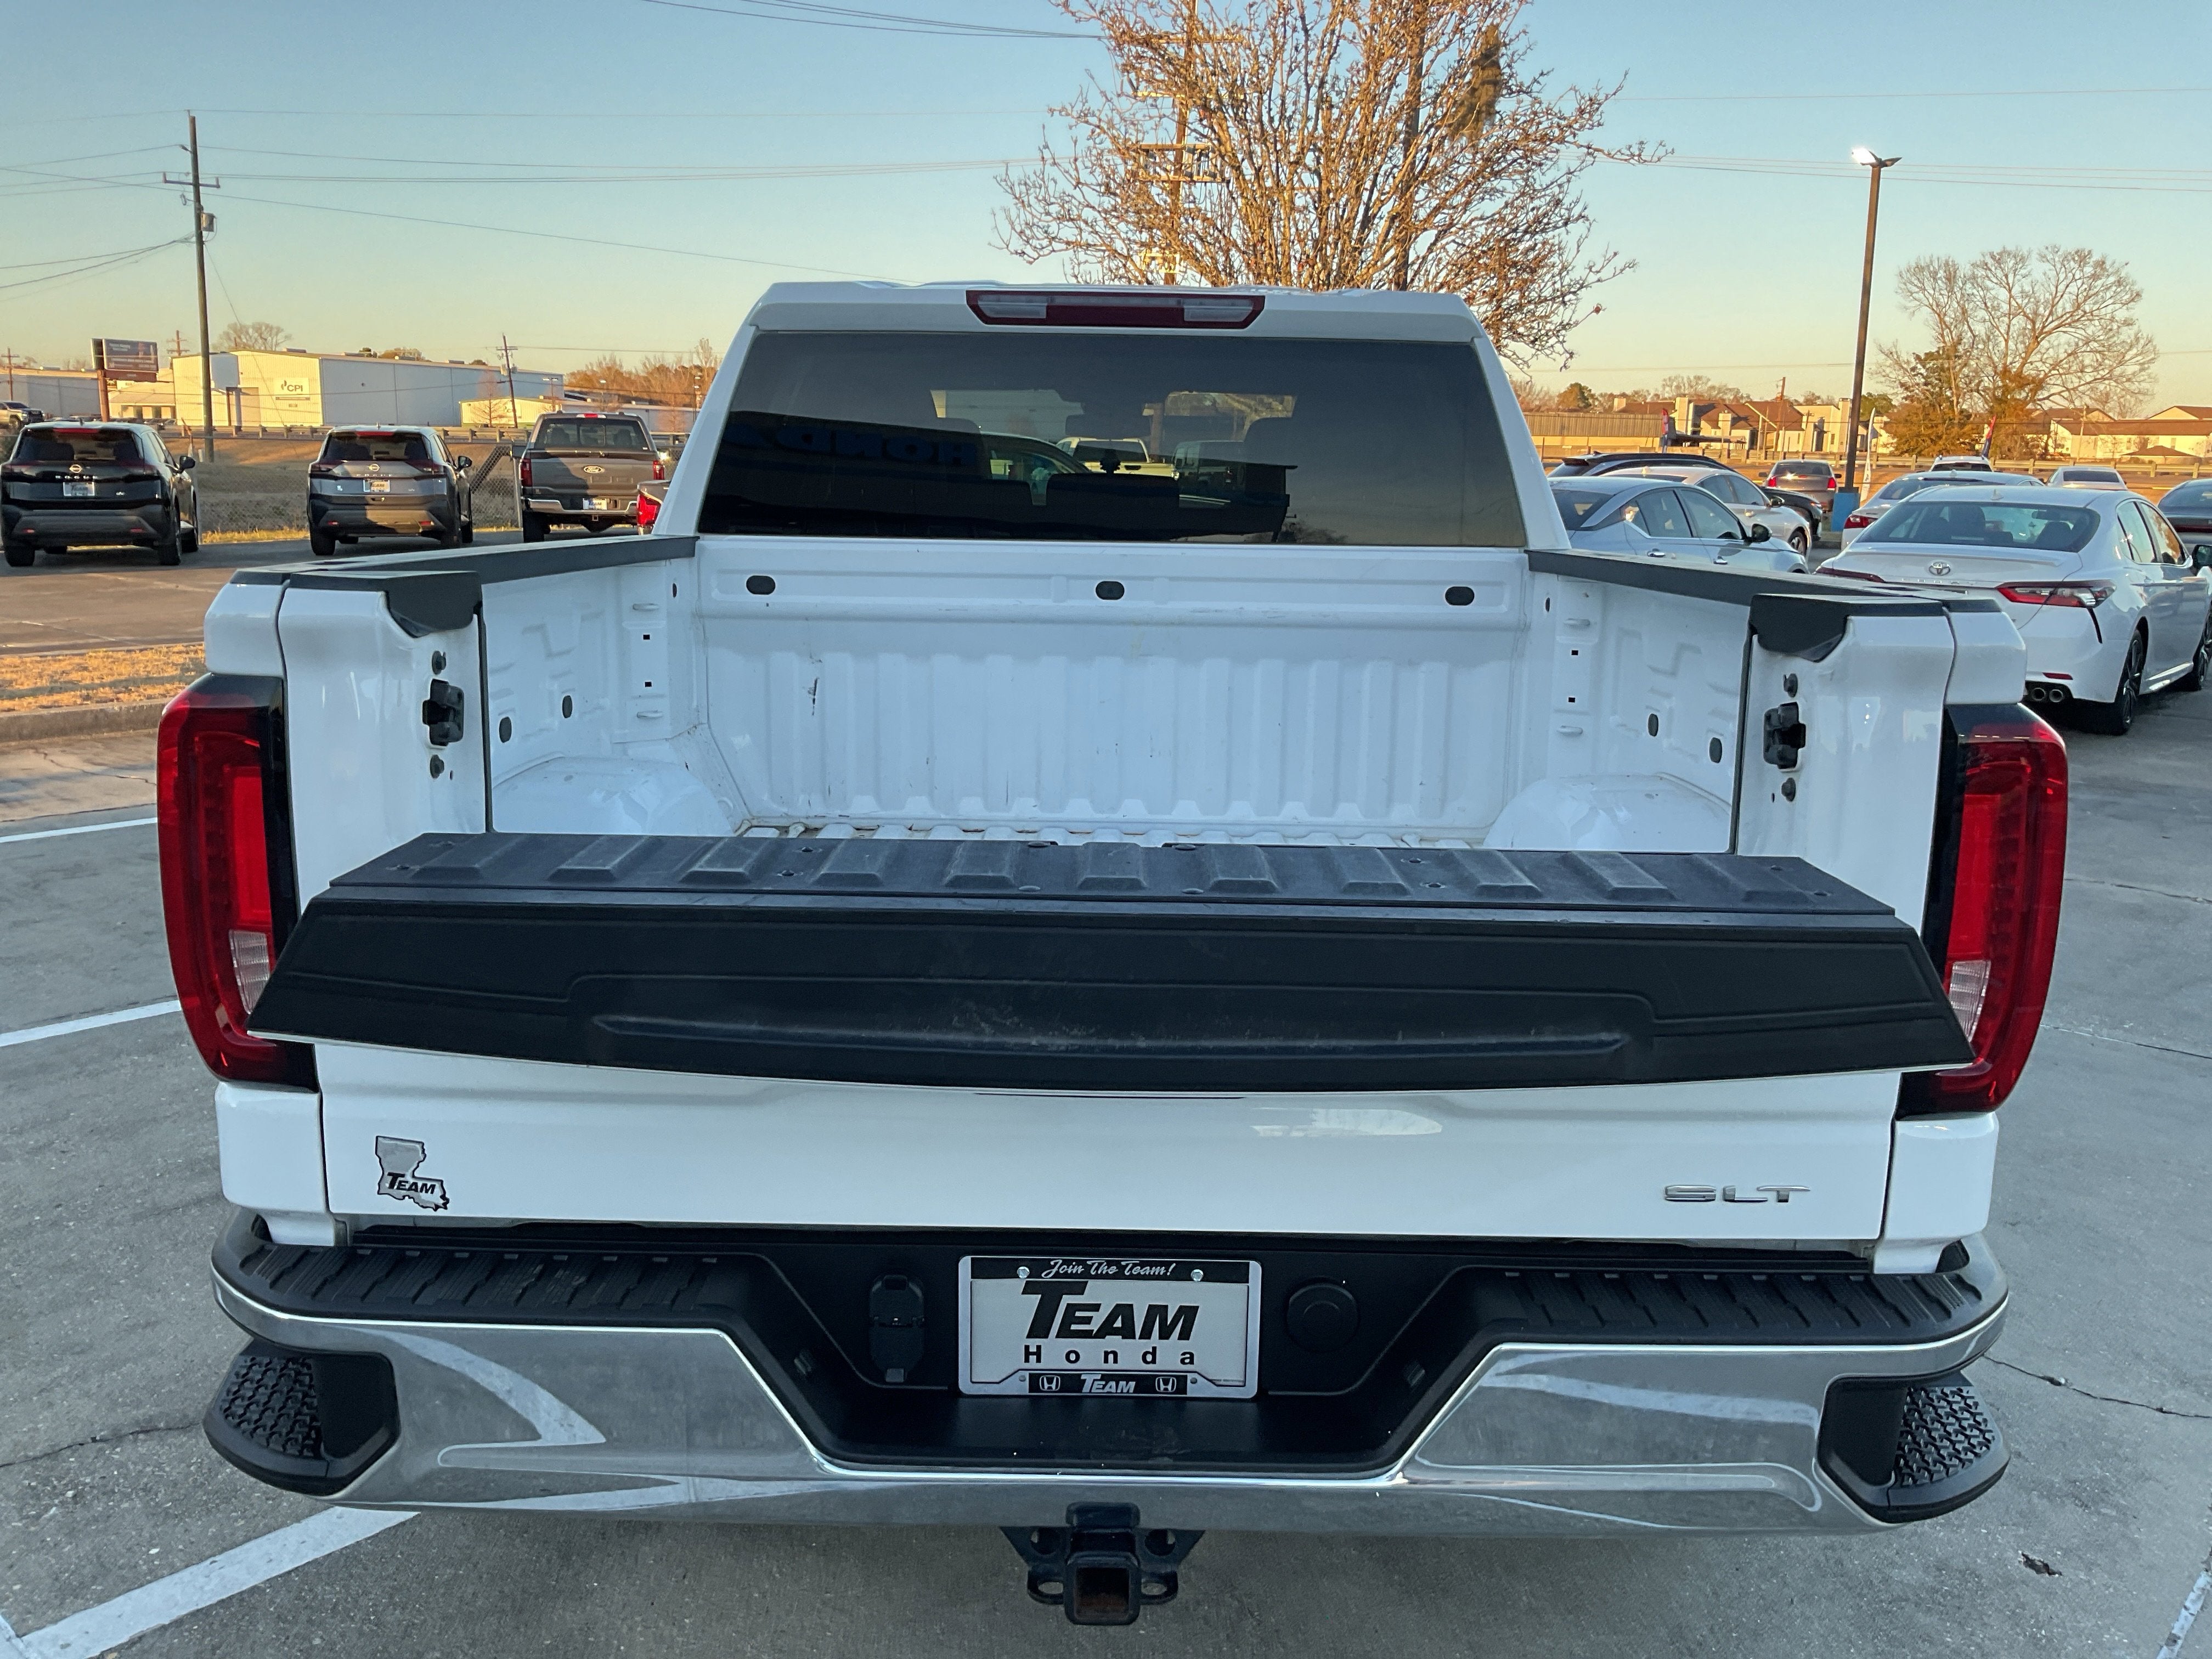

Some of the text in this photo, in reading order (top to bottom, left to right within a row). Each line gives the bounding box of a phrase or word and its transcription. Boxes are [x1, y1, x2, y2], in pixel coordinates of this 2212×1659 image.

[387, 1172, 436, 1195] TEAM
[1664, 1184, 1811, 1203] SLT
[1041, 1259, 1176, 1278] Join The Team!
[1021, 1280, 1200, 1341] TEAM
[1024, 1344, 1195, 1365] Honda
[1081, 1374, 1136, 1393] TEAM
